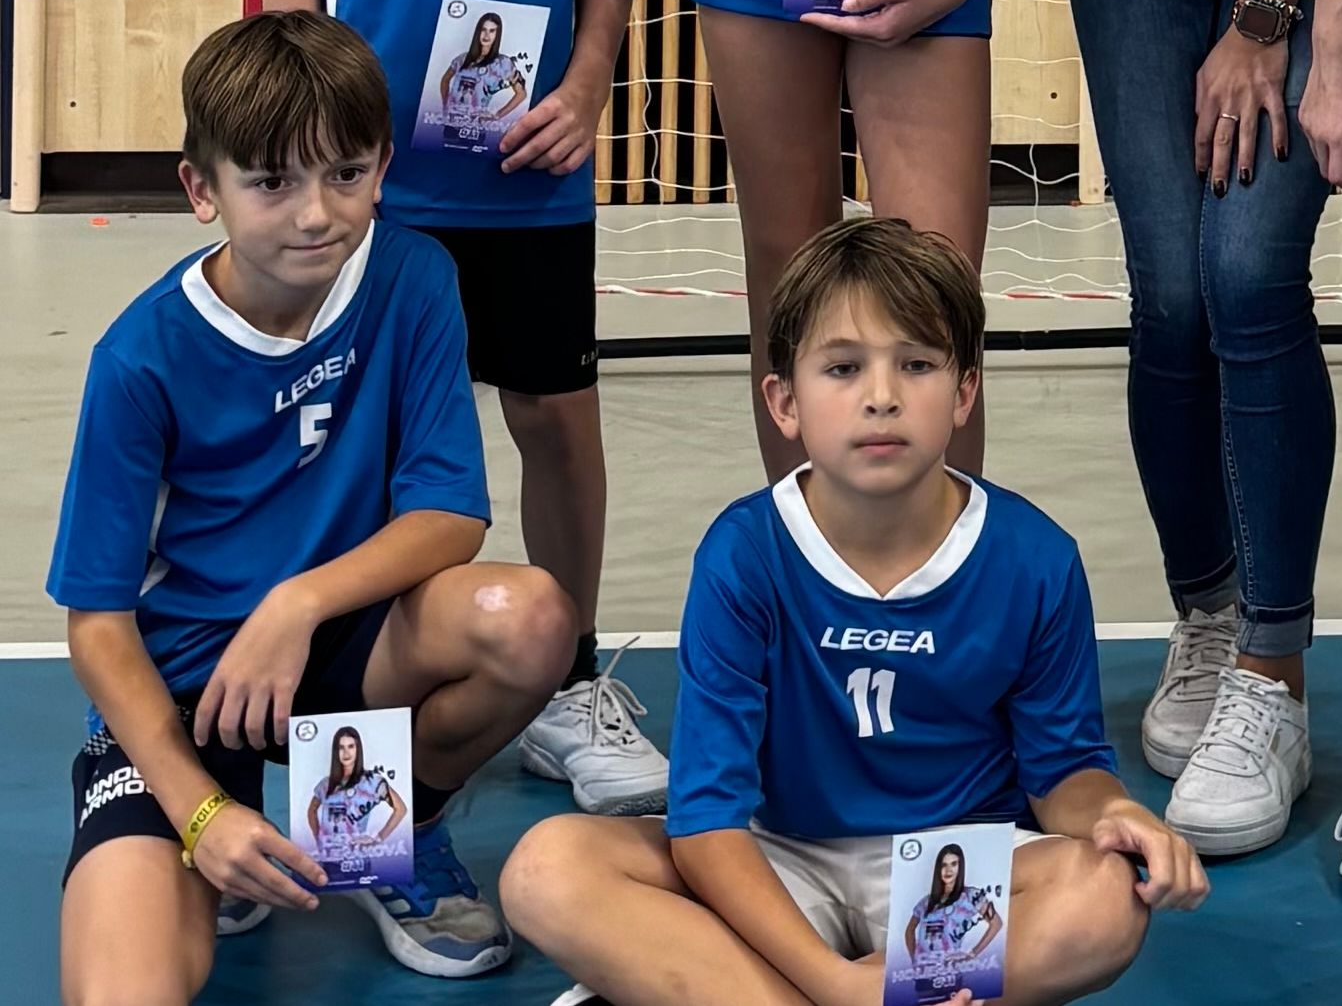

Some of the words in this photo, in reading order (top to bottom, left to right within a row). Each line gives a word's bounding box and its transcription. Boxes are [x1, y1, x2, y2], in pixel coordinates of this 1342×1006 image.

[275, 347, 356, 414] LEGEA
[296, 402, 332, 469] 5
[820, 626, 935, 654] LEGEA
[846, 667, 896, 738] 11
[79, 779, 153, 828] ARMO
[86, 766, 142, 804] UND
